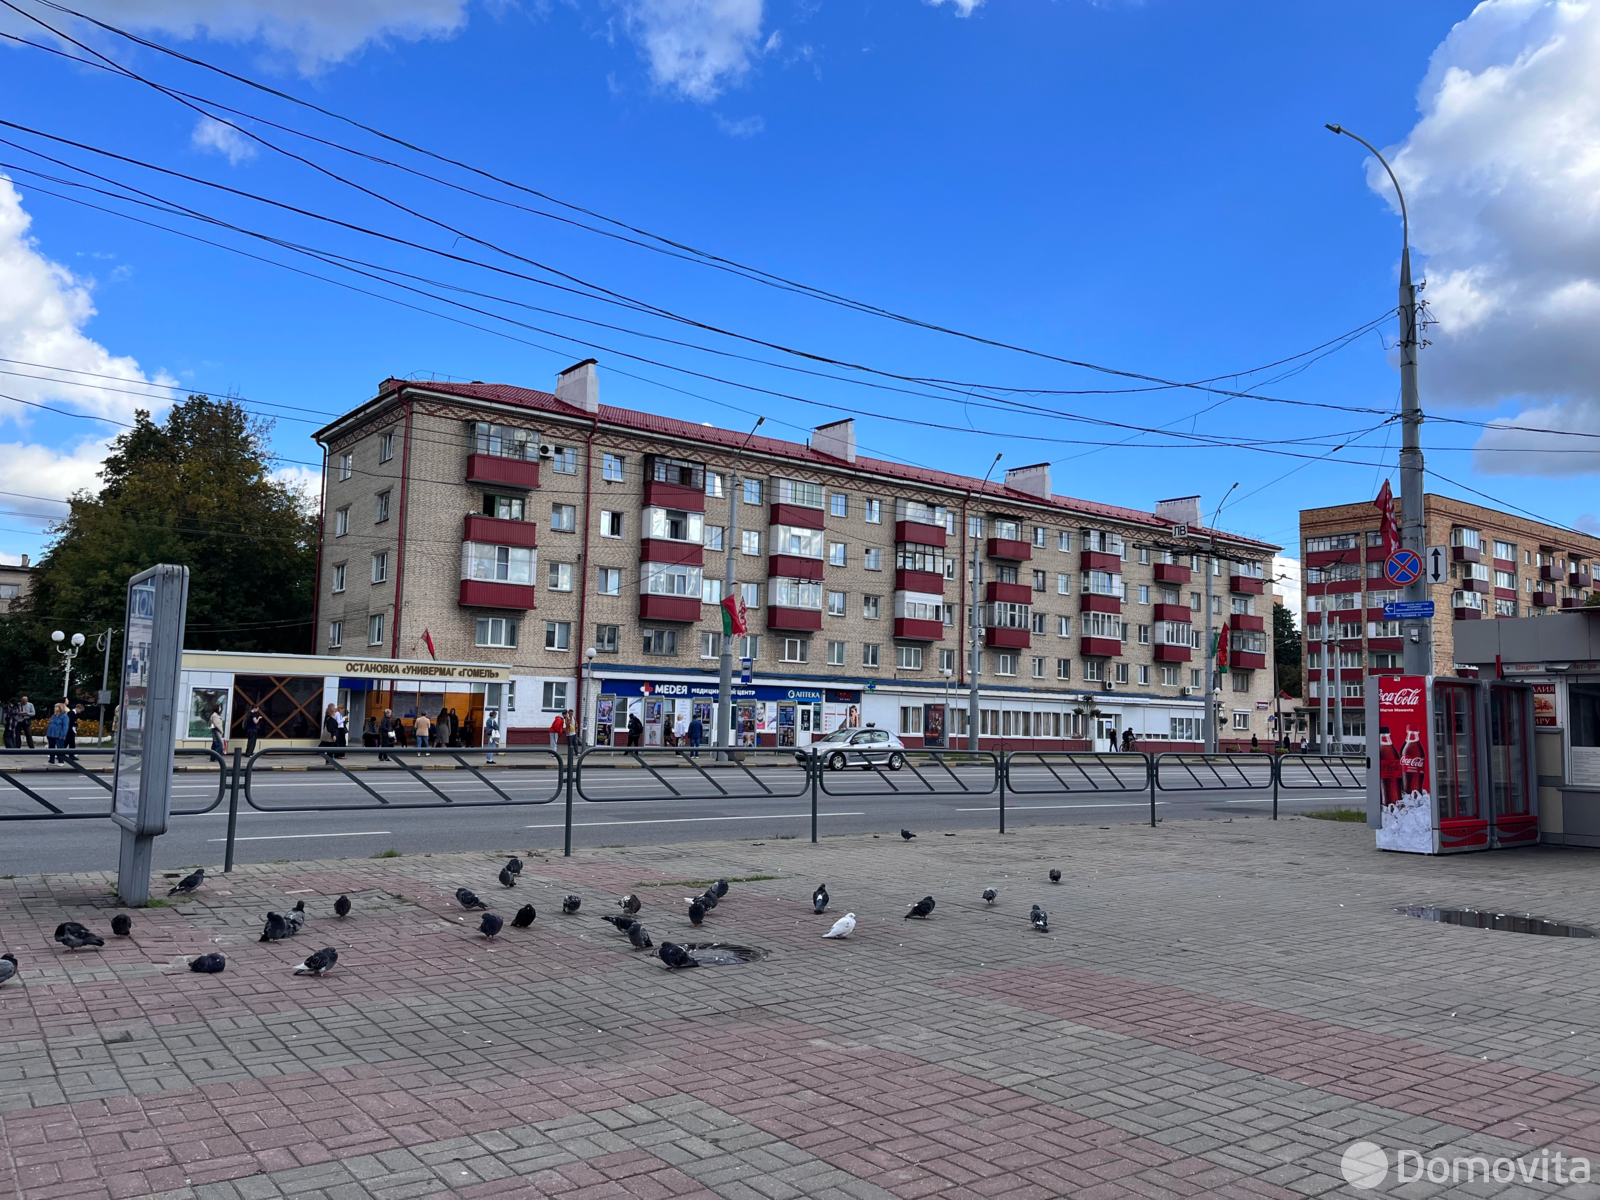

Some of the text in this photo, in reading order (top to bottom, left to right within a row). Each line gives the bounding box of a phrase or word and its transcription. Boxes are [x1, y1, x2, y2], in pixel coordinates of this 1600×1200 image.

[345, 663, 500, 679] ОСТАНОВКА «УНИВЕРМАГ «ГОМЕЛЬ»
